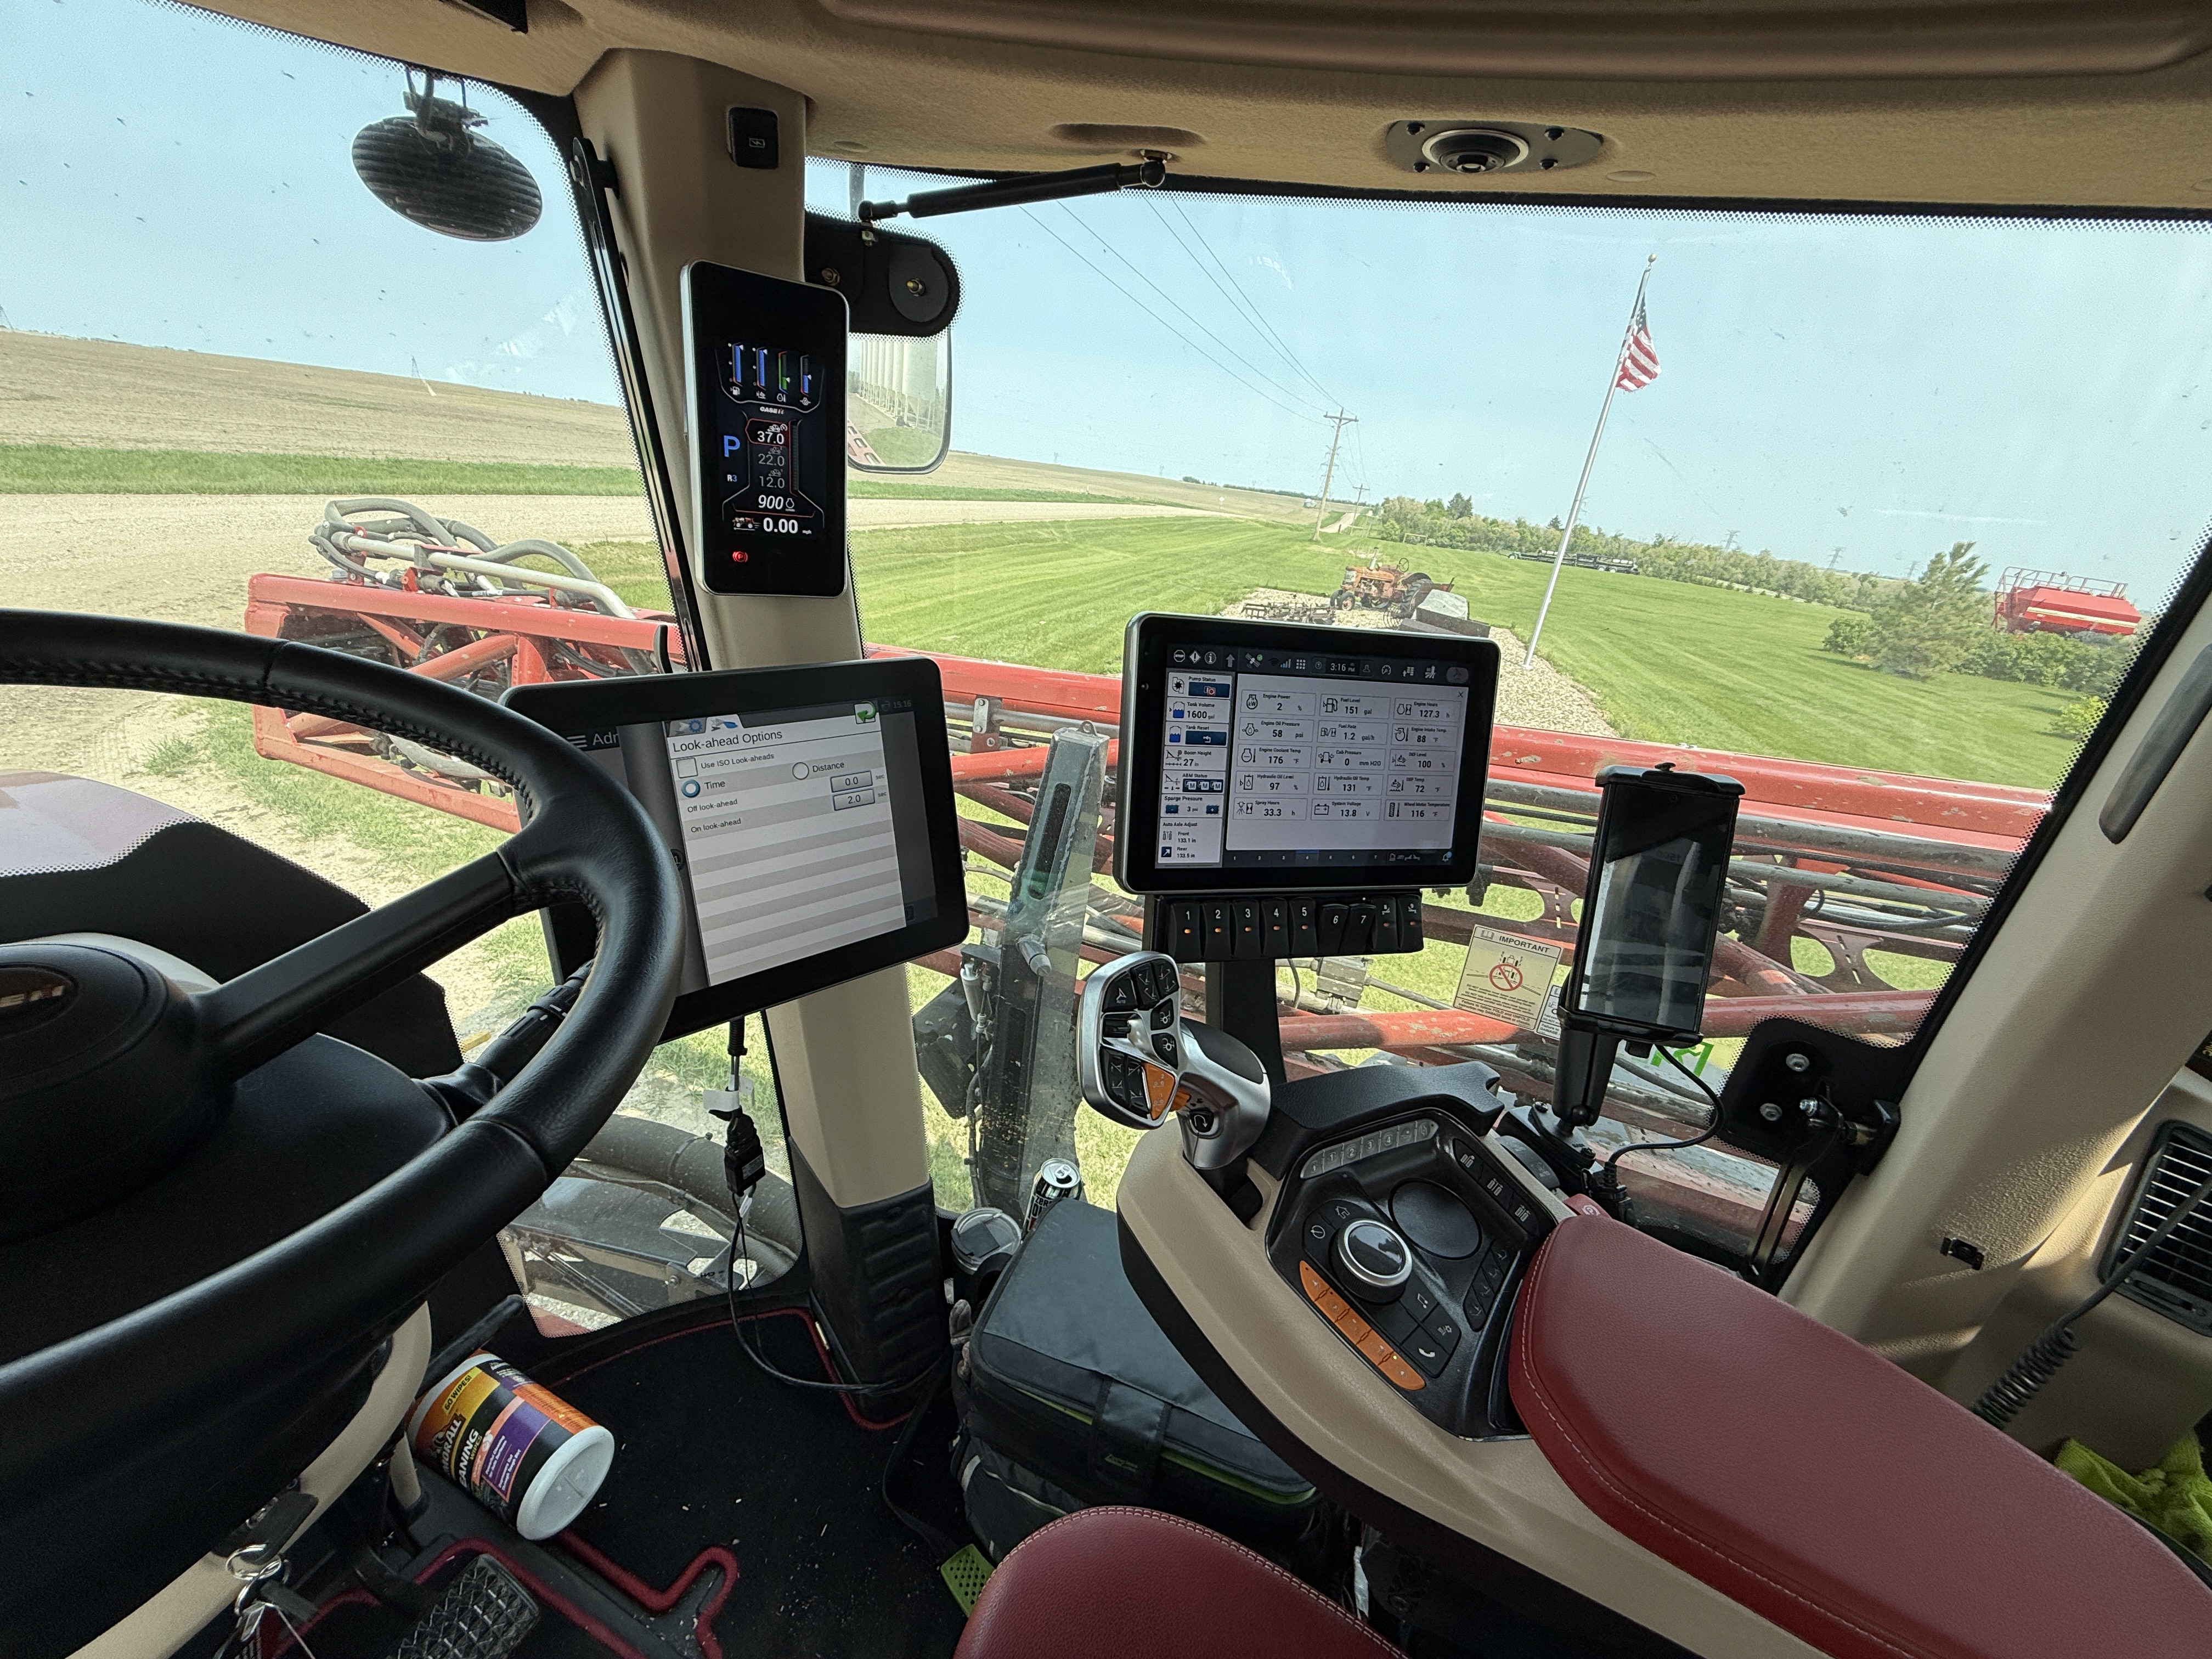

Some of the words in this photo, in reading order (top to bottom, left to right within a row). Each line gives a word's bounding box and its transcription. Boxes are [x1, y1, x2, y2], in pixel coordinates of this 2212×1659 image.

[757, 431, 785, 444] 37.0
[724, 435, 740, 457] P
[758, 454, 785, 466] 22.0
[759, 476, 785, 488] 12.0
[758, 494, 784, 510] 900
[763, 517, 798, 534] 0.00
[1330, 663, 1346, 672] 3:16
[893, 700, 912, 708] 15:16
[1187, 710, 1207, 719] 1600
[1419, 709, 1440, 718] 127.3
[673, 735, 739, 752] Look-ahead
[742, 731, 782, 744] Options
[732, 753, 774, 765] Look-aheads
[1268, 756, 1283, 764] 176
[1418, 760, 1431, 768] 100
[812, 761, 844, 772] Distance
[704, 781, 725, 789] Time
[845, 776, 859, 786] 0.0
[699, 799, 738, 811] look-ahead
[848, 794, 861, 804] 2.0
[703, 818, 741, 831] look-ahead
[1186, 911, 1190, 921] 1
[1215, 910, 1221, 919] 2
[1245, 909, 1251, 918] 3
[1273, 908, 1279, 917] 4
[1301, 907, 1307, 917] 5
[1333, 915, 1339, 924] 6
[1361, 915, 1366, 924] 7
[1499, 935, 1550, 953] IMPORTANT
[1485, 1009, 1501, 1018] DAMAGE
[1513, 1014, 1530, 1022] UNFOLD
[1539, 1027, 1558, 1035] DAMAGE
[1350, 1148, 1355, 1156] 2
[1368, 1141, 1372, 1149] 3
[452, 1375, 472, 1400] WIPES!
[470, 1435, 483, 1460] WIPES
[459, 1428, 479, 1488] EANING
